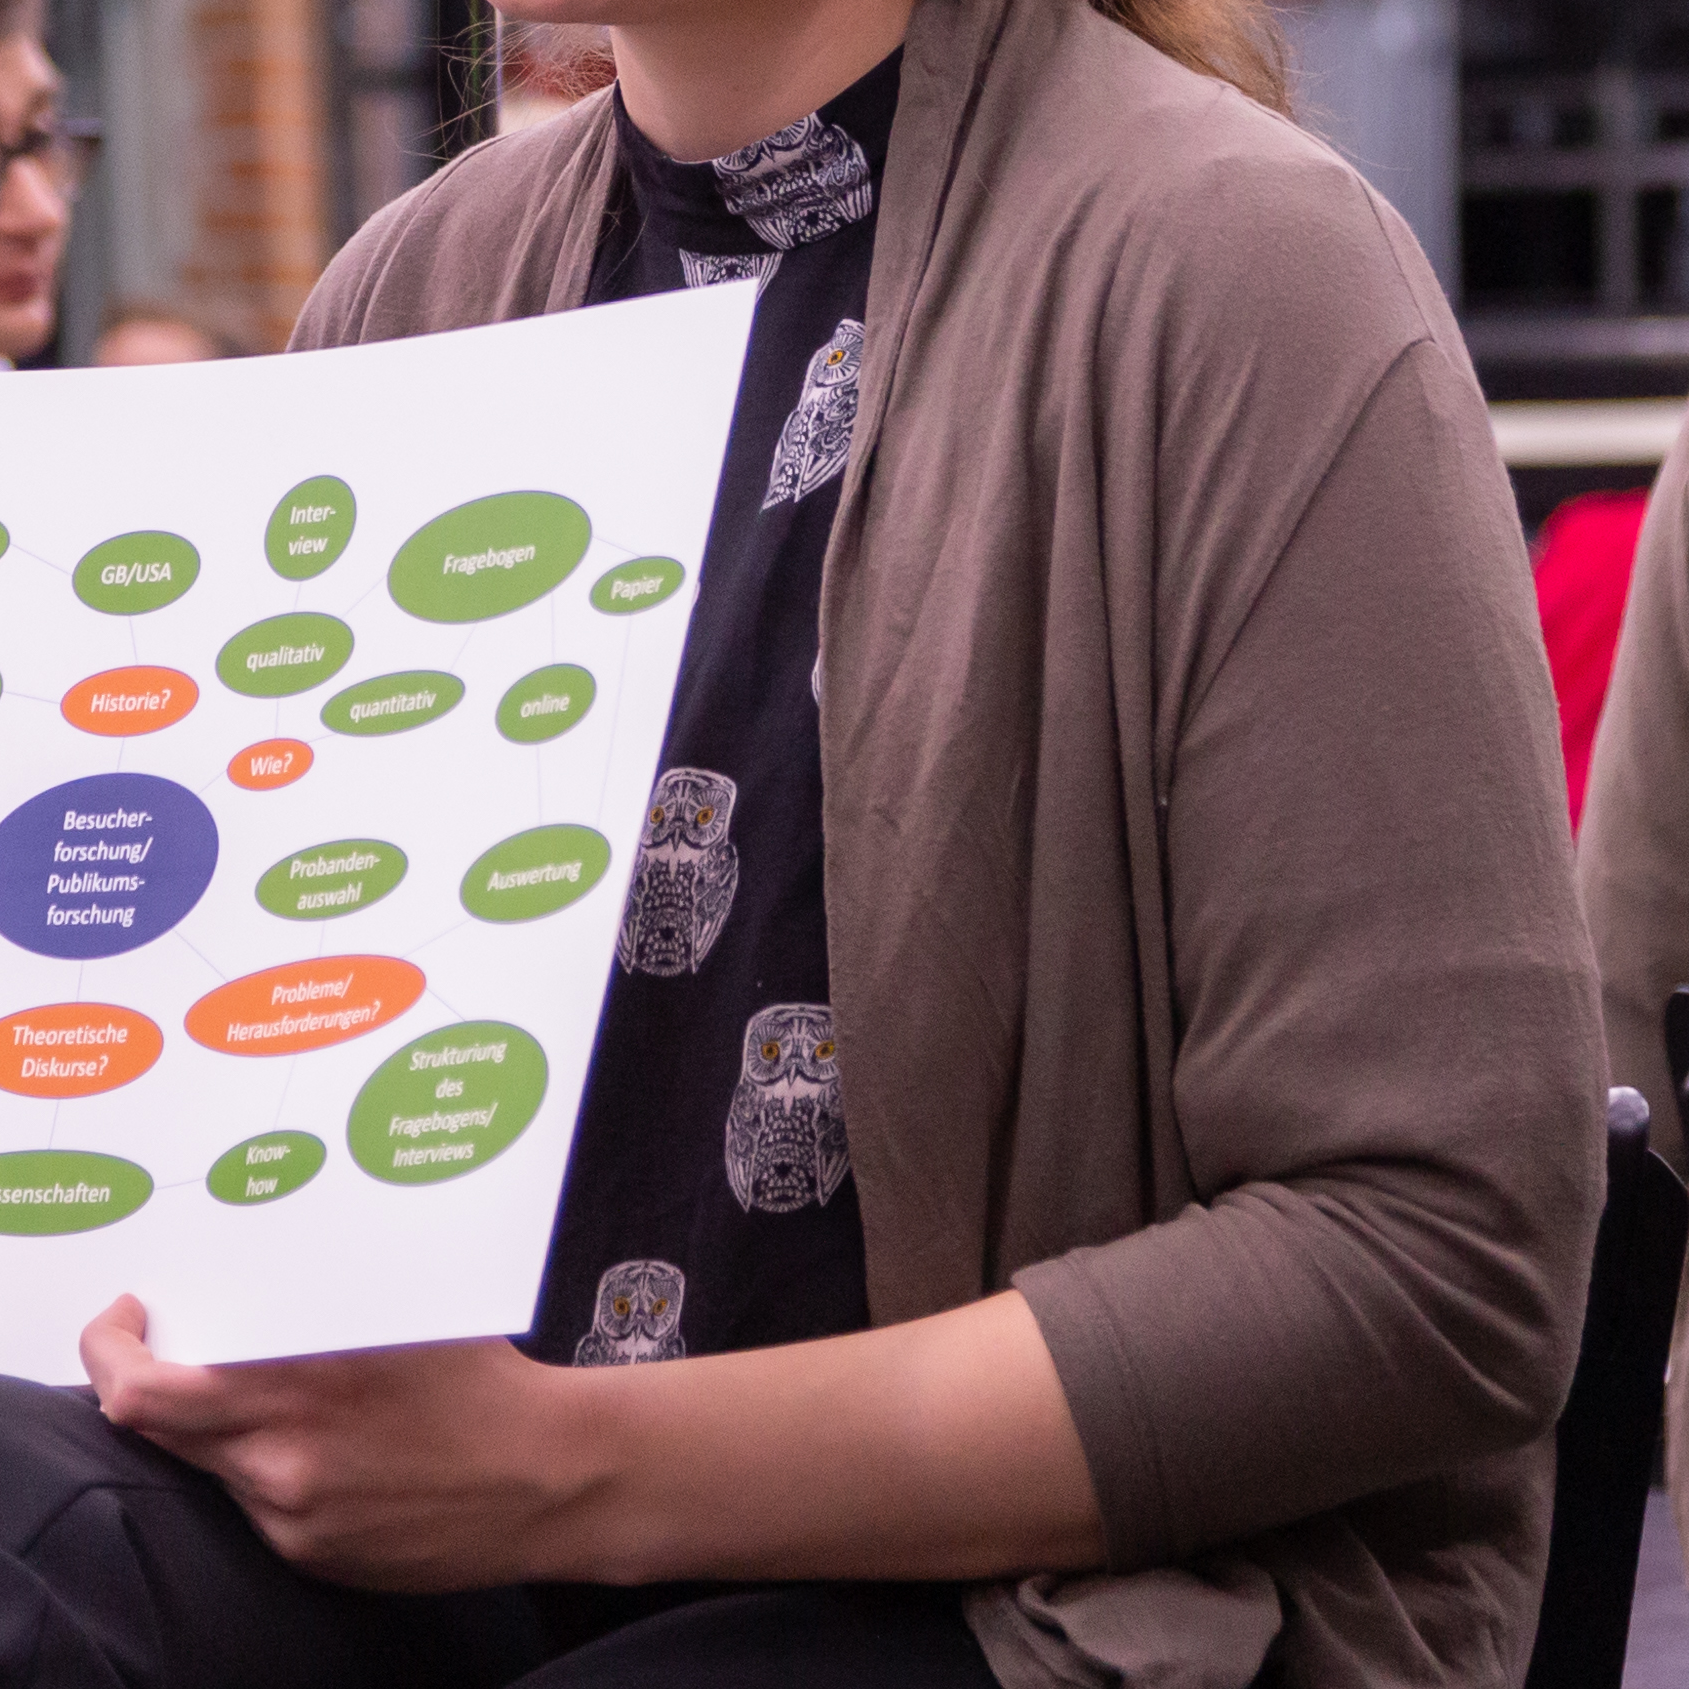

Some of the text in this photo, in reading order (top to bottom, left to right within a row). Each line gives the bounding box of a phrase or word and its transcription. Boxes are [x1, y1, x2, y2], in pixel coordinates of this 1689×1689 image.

[289, 505, 337, 525] Inter-
[288, 535, 329, 556] view
[442, 544, 536, 576] Fragebogen
[100, 562, 172, 587] GB/USA
[611, 575, 664, 601] Papier
[246, 642, 325, 673] qualitativ
[90, 688, 172, 713] Historie?
[349, 689, 437, 724] quantitativ
[519, 693, 571, 718] online
[250, 751, 294, 777] Wie?
[63, 807, 153, 831] Besucher-
[53, 836, 154, 864] forschung/
[289, 851, 382, 879] Probanden-
[486, 860, 583, 892] Auswertung
[46, 871, 146, 894] Publikums-
[296, 881, 363, 911] auswahl
[46, 903, 136, 928] forschung
[271, 973, 354, 1006] Probleme/
[226, 999, 382, 1042] Herausforderungen?
[12, 1023, 129, 1046] Theoretische
[20, 1054, 109, 1078] Diskurse?
[435, 1077, 464, 1099] des
[388, 1102, 499, 1139] Fragebogens/
[245, 1142, 291, 1166] Know-
[392, 1142, 475, 1168] Interviews
[245, 1176, 279, 1198] how
